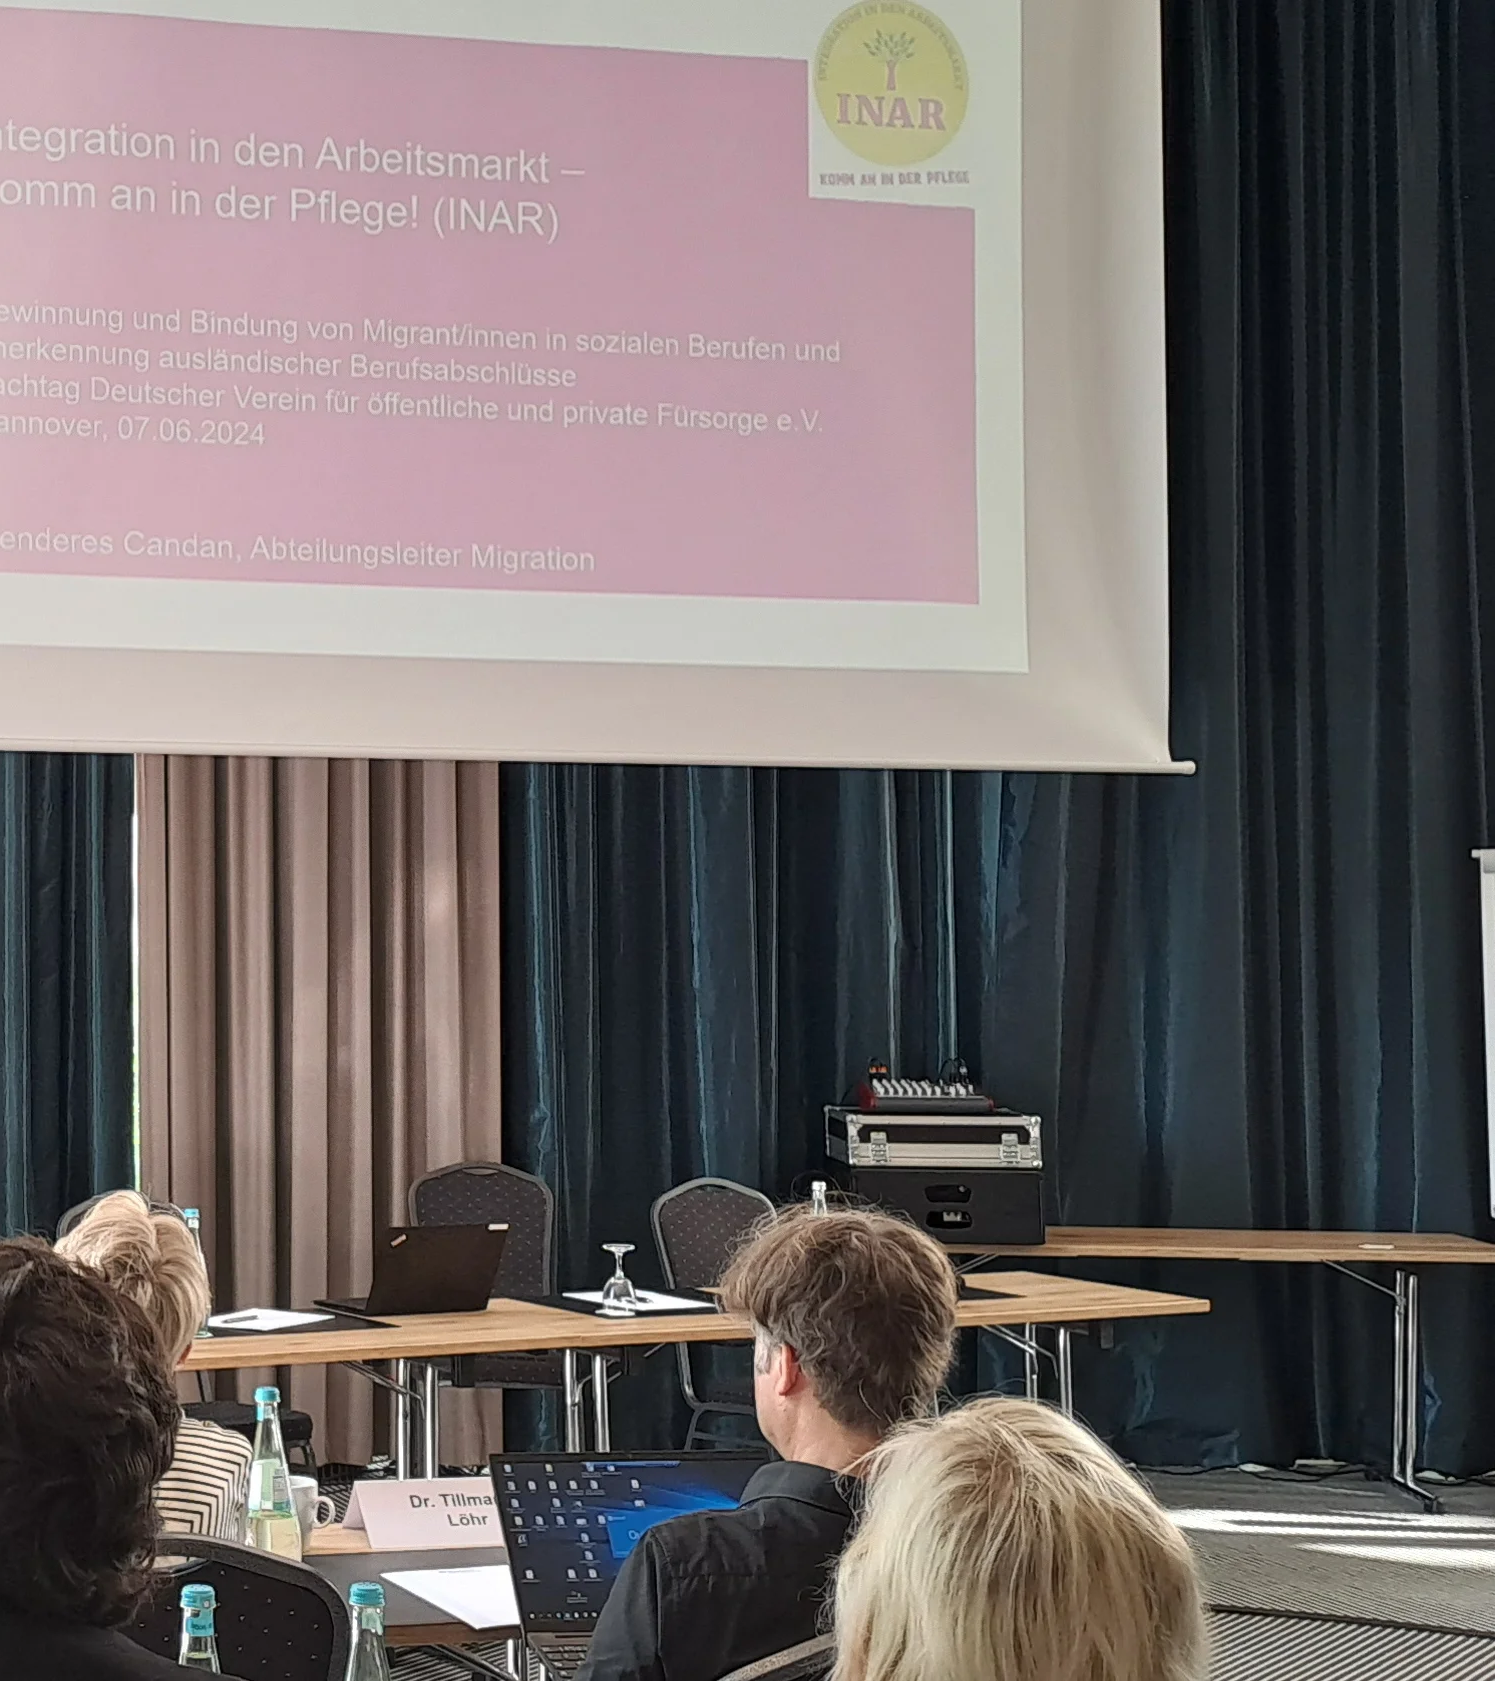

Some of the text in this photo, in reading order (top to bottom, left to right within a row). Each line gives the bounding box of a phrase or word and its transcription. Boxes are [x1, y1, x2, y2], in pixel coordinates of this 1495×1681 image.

[836, 92, 947, 132] INAR
[189, 128, 220, 164] in
[234, 132, 304, 170] den
[314, 136, 551, 184] Arbeitsmarkt
[819, 169, 970, 186] KOMM AN IN DER PFLEGE
[110, 184, 156, 213] an
[171, 180, 201, 217] in
[214, 184, 278, 221] der
[290, 187, 418, 235] Pflege!
[433, 195, 559, 246] (INAR)
[133, 308, 181, 333] und
[191, 309, 298, 345] Bindung
[306, 320, 354, 342] von
[363, 317, 537, 350] Migrant/innen
[545, 326, 567, 352] in
[575, 330, 679, 357] sozialen
[688, 333, 786, 361] Berufen
[794, 339, 841, 363] und
[158, 346, 343, 377] ausländischer
[350, 353, 577, 388] Berufsabschlüsse
[90, 376, 227, 408] Deutscher
[233, 384, 316, 412] Verein
[324, 388, 361, 415] für
[367, 391, 499, 420] öffentliche
[507, 399, 554, 423] und
[563, 399, 649, 429] private
[657, 402, 769, 437] Fürsorge
[776, 408, 823, 433] e.V.
[117, 415, 266, 446] 07.06.2024
[123, 530, 242, 564] Candan,
[249, 535, 463, 570] Abteilungsleiter
[471, 543, 595, 575] Migration
[409, 1492, 496, 1509] Dr. Tillma
[446, 1513, 488, 1526] Löhr
